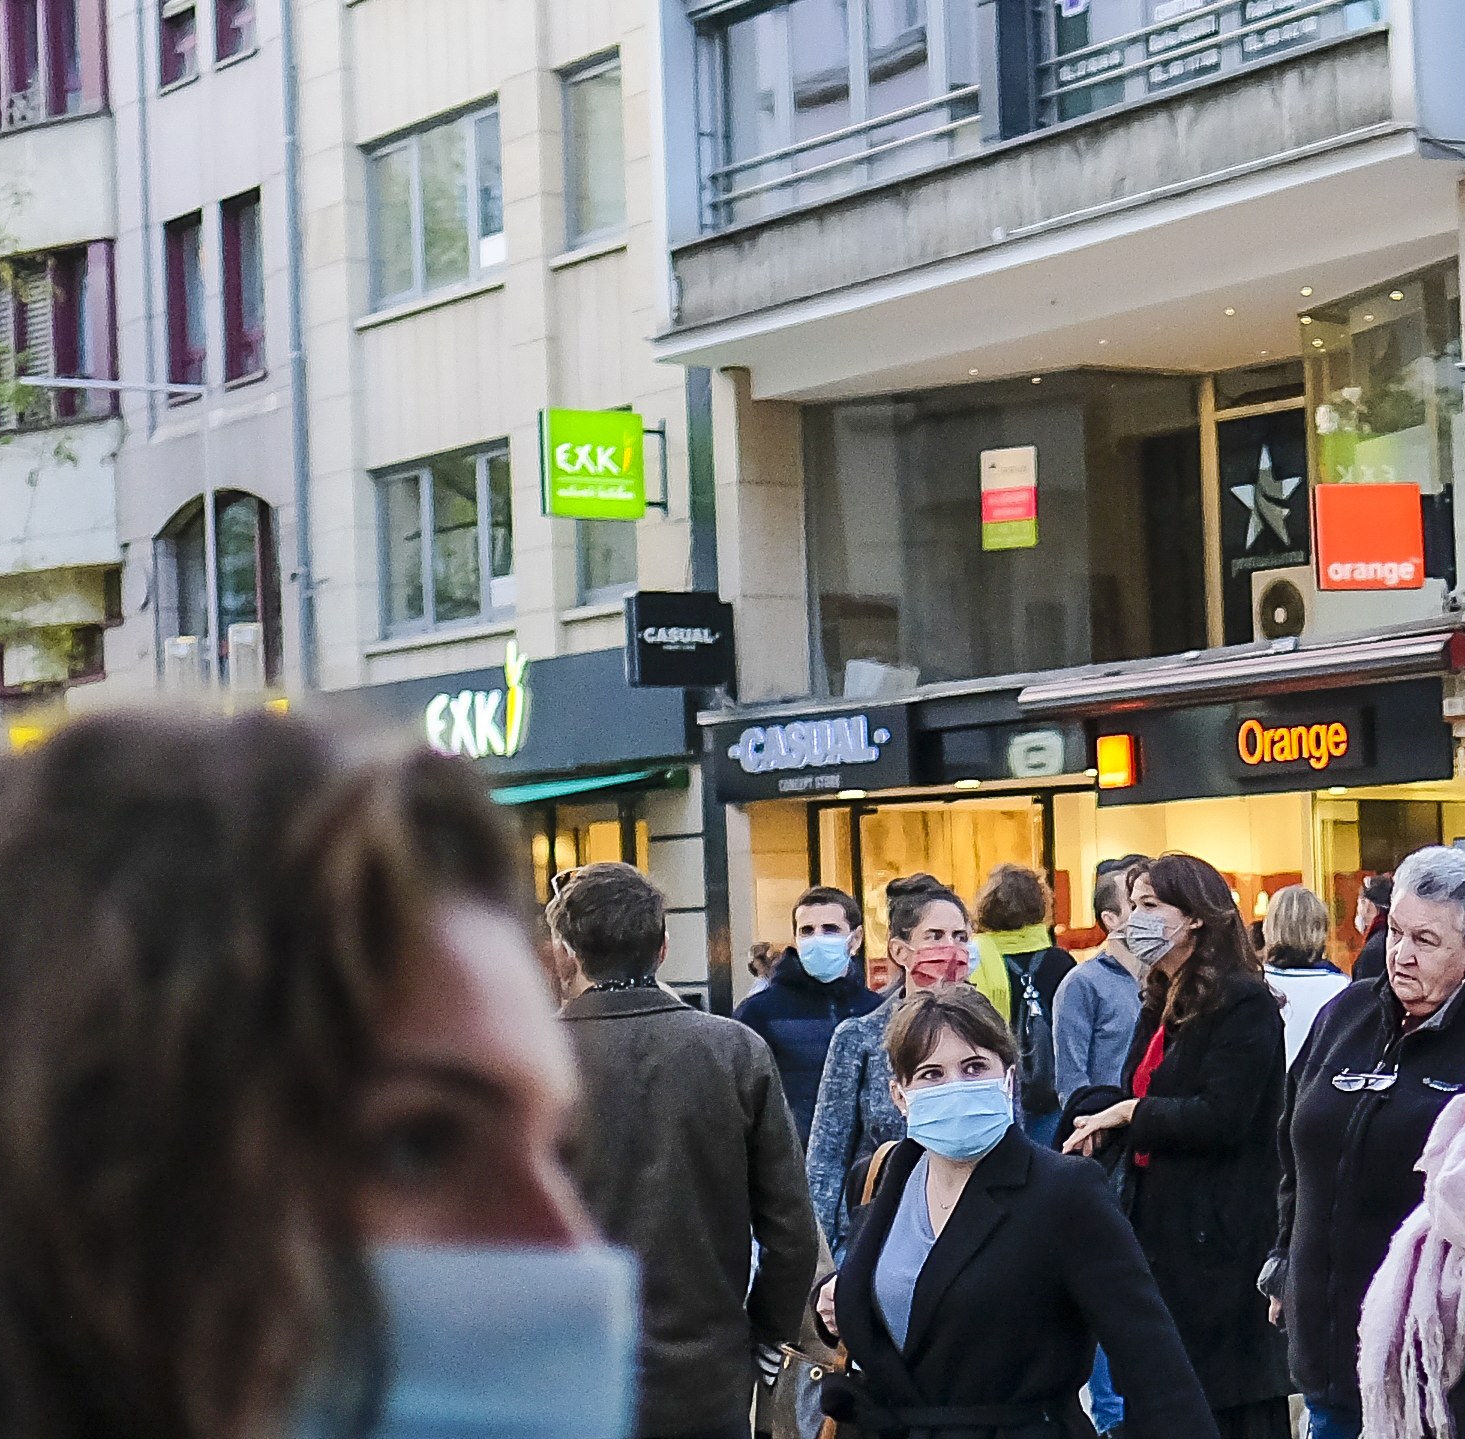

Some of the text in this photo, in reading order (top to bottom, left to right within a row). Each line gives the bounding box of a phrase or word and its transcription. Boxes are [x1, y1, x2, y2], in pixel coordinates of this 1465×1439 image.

[1327, 560, 1416, 586] orange
[642, 626, 714, 644] CASUAL
[739, 714, 880, 774] CASUAL
[1238, 718, 1349, 770] Orange
